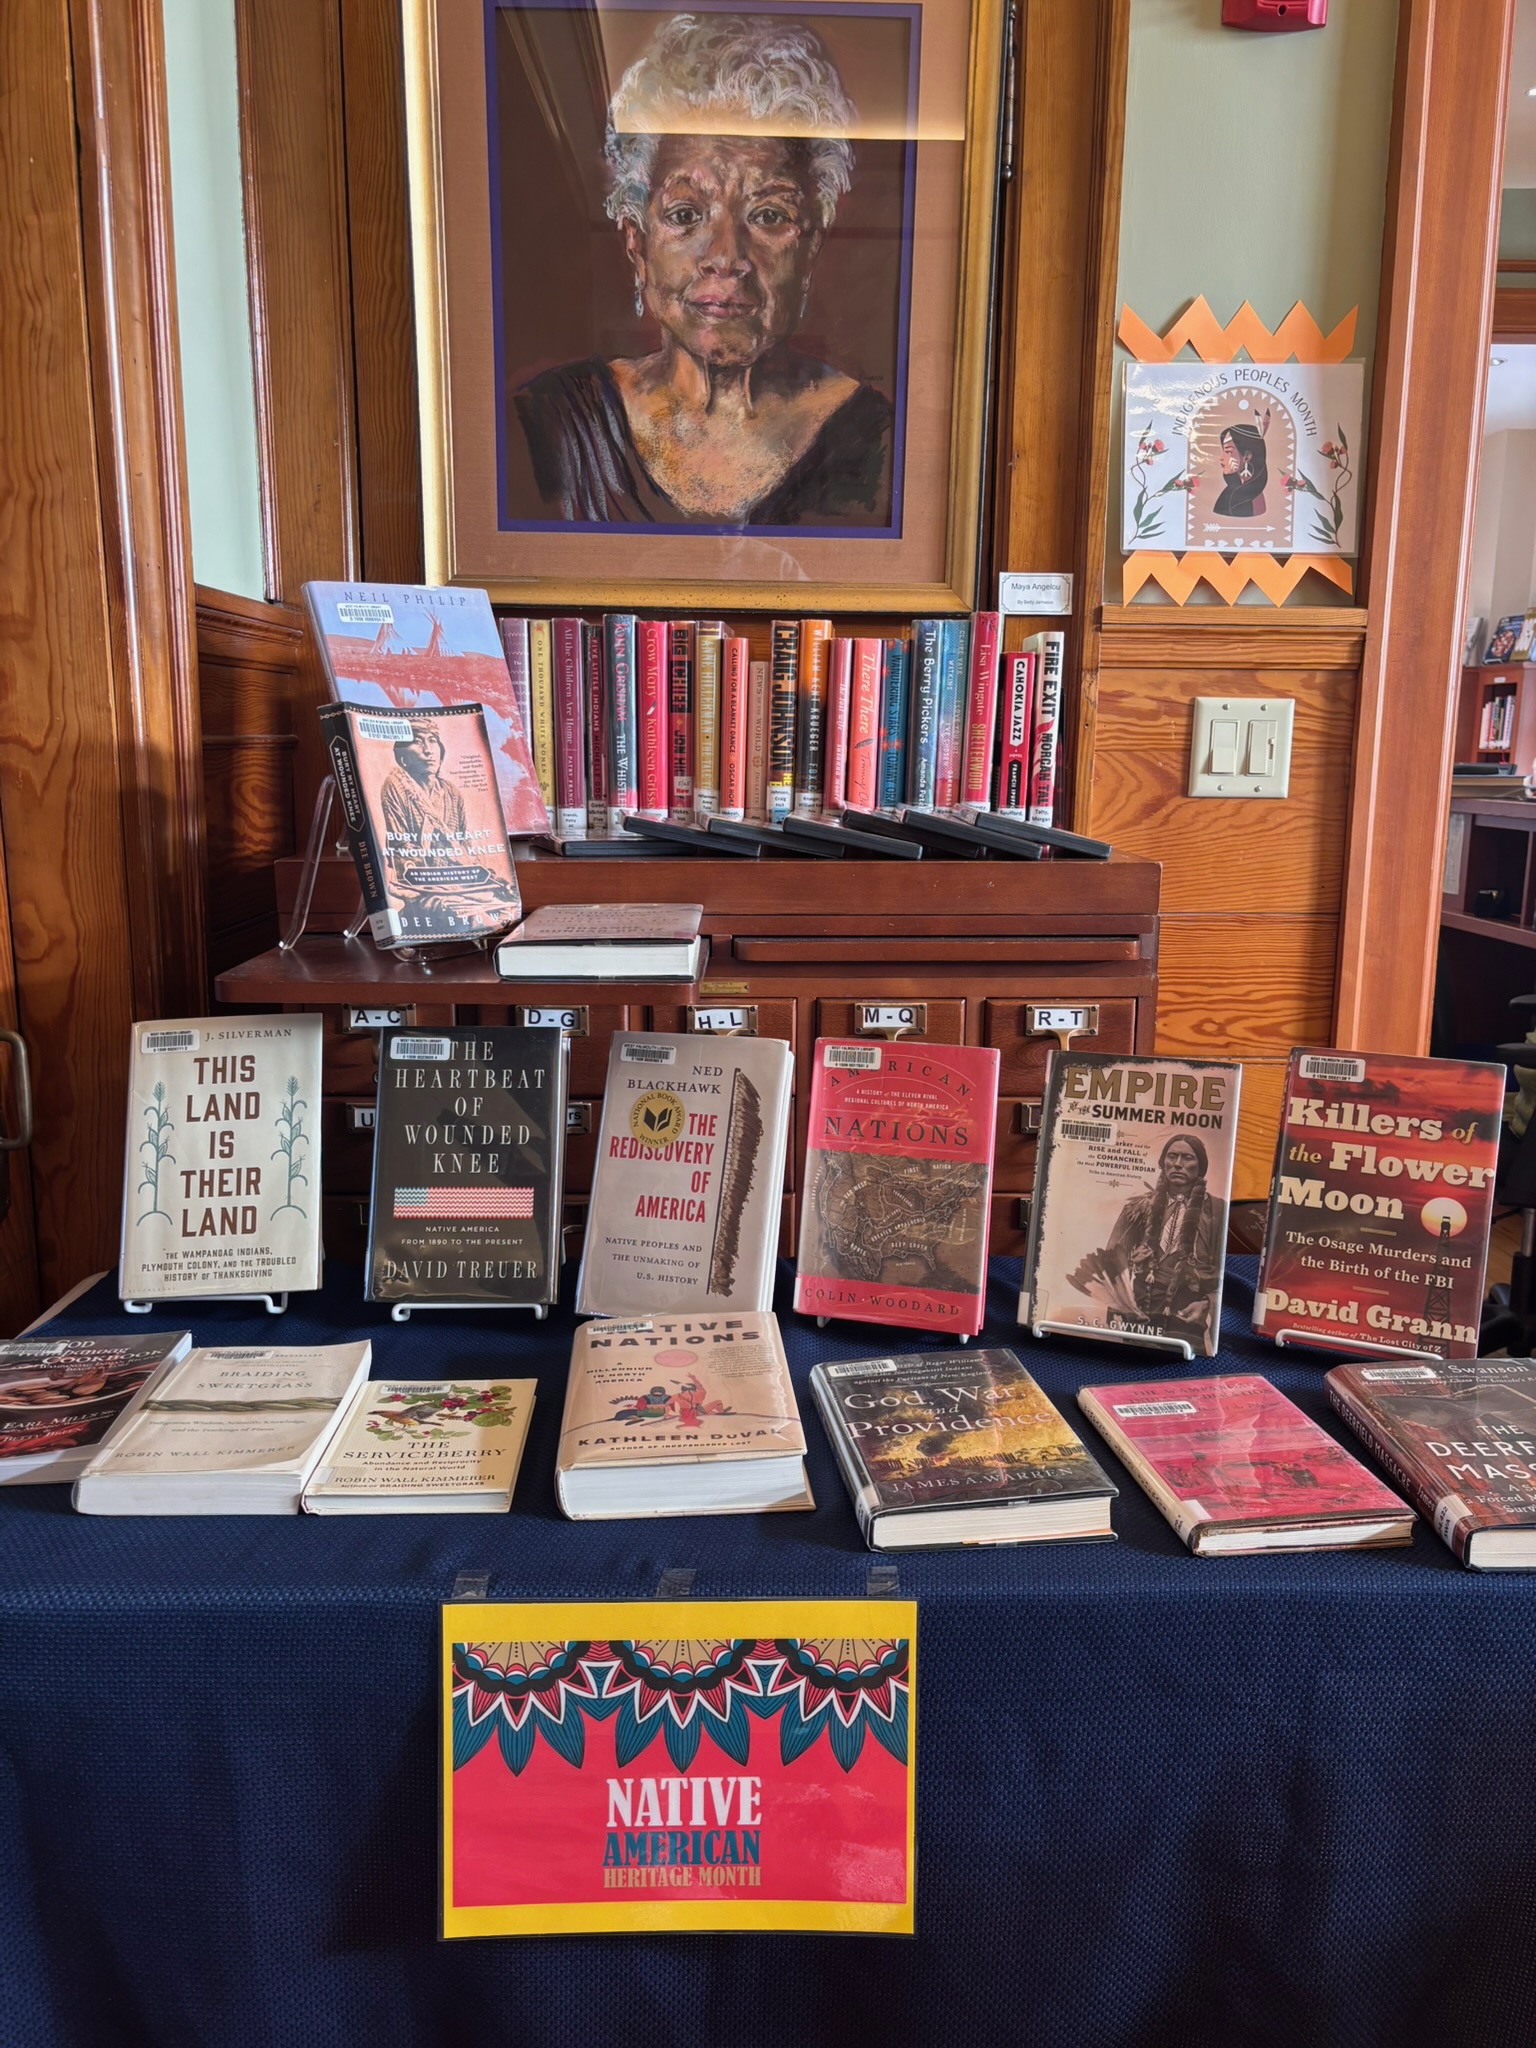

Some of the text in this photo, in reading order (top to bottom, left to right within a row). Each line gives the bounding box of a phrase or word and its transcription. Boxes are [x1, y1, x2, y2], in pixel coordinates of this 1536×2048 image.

[1171, 368, 1319, 437] INDIGENOUS PEOPLES MONTH
[344, 591, 467, 606] NEIL PHILIP
[1011, 583, 1061, 591] Maya Angelou
[614, 623, 629, 721] JOHN GRISHAM
[645, 628, 657, 698] Crow Mary
[672, 629, 689, 709] BIG CHIEF
[809, 629, 822, 751] WILLIAM KENT KRUEGER
[920, 630, 937, 744] The Berry Pickers
[974, 644, 991, 716] Lisa Wingate
[1041, 641, 1060, 718] FIRE EXIT
[770, 626, 798, 770] CRAIG JOHNSON
[859, 653, 876, 734] There There
[888, 654, 902, 736] WANDERING STARS
[1012, 661, 1025, 741] CAHOKIA JAZZ
[968, 723, 986, 790] SHELTERWOOD
[919, 757, 928, 789] Amanda
[387, 829, 491, 841] BURY MY HEART
[382, 843, 506, 858] AT WOUNDED KNEE
[358, 841, 378, 899] DEE BROWN
[205, 1029, 292, 1041] J. SILVERMAN
[450, 1041, 494, 1060] THE
[193, 1055, 256, 1085] THIS
[395, 1069, 545, 1089] HEARTBEAT
[692, 1065, 723, 1077] NED
[627, 1079, 721, 1094] BLACKHAWK
[1064, 1066, 1226, 1111] EMPIRE
[186, 1091, 260, 1123] LAND
[454, 1096, 484, 1117] OF
[688, 1113, 718, 1137] THE
[824, 1116, 968, 1146] NATIONS
[1287, 1096, 1479, 1144] Killers of
[209, 1130, 234, 1159] IS
[405, 1125, 531, 1145] WOUNDED
[640, 1133, 669, 1145] WINNER
[609, 1135, 714, 1165] REDISCOVERY
[433, 1153, 500, 1173] KNEE
[1289, 1141, 1495, 1188] the Flower
[180, 1167, 261, 1199] THEIR
[690, 1170, 711, 1194] OF
[635, 1195, 705, 1223] AMERICA
[1277, 1176, 1404, 1220] Moon
[181, 1205, 257, 1238] LAND
[165, 1247, 273, 1259] THE WAMPANOAG INDIANS,
[605, 1236, 702, 1253] NATIVE PEOPLES AND
[1286, 1230, 1472, 1269] The Osage Murders and
[142, 1257, 296, 1272] PLYMOUTH COLONY, AND THE TROUBLED
[386, 1260, 538, 1279] DAVID TREUER
[612, 1253, 700, 1268] THE UNMAKING OF
[1301, 1255, 1454, 1289] the Birth of the FBI
[164, 1269, 273, 1282] HISTORY OF THANKSGIVING
[636, 1271, 698, 1285] U.S. HISTORY
[805, 1287, 959, 1316] COLIN WOODARD
[1265, 1288, 1477, 1344] David Grann
[590, 1331, 760, 1348] NATIONS
[42, 1348, 163, 1364] COOKBOOK
[586, 1366, 652, 1374] MILLENNIUM
[1448, 1364, 1529, 1374] Swanson
[196, 1381, 313, 1389] SWEETGRASS
[844, 1385, 1027, 1409] God, War,
[923, 1404, 960, 1415] and
[845, 1411, 1053, 1438] Providence
[1476, 1425, 1524, 1435] THE
[216, 1445, 296, 1455] KIMMERER
[408, 1441, 450, 1449] THE
[578, 1434, 699, 1446] KATHLEEN
[1329, 1390, 1435, 1511] THE DEERFIELD MASSACRE James
[343, 1449, 507, 1459] SERVICEBERRY
[1475, 1494, 1523, 1503] Forced
[606, 1776, 762, 1827] NATIVE
[602, 1829, 761, 1867] AMERICAN
[603, 1866, 761, 1888] HERITAGE MONTH
